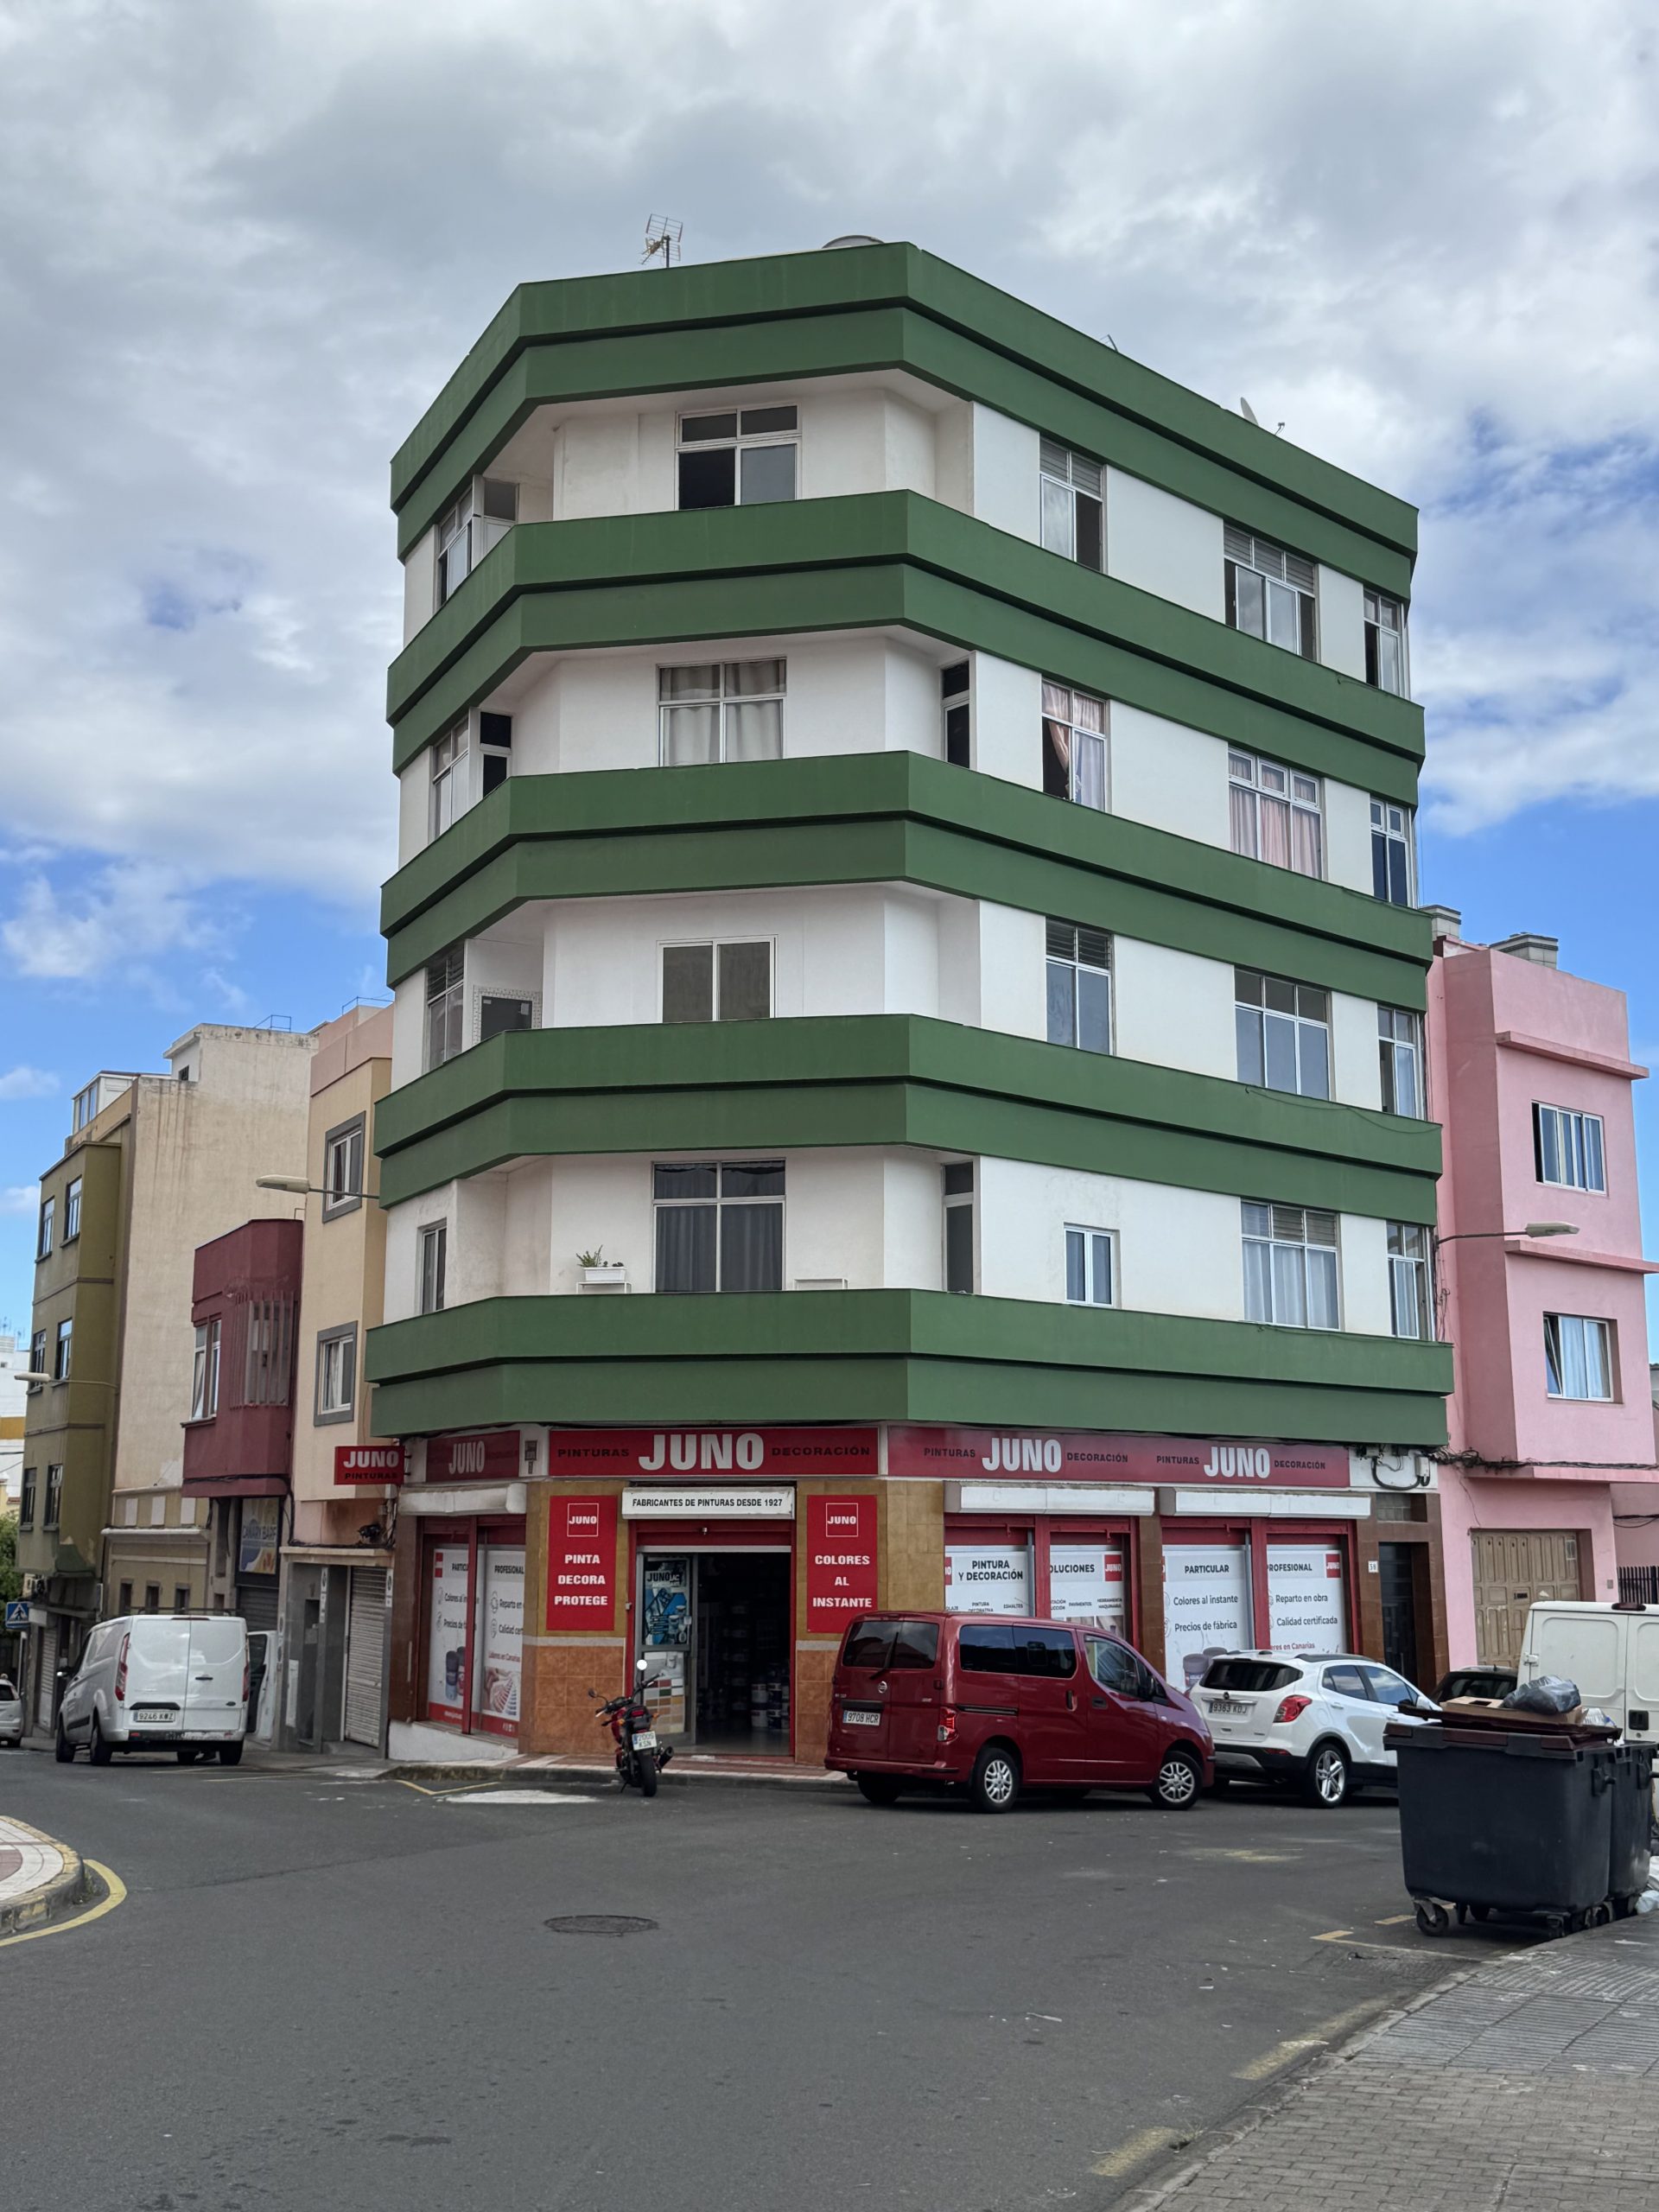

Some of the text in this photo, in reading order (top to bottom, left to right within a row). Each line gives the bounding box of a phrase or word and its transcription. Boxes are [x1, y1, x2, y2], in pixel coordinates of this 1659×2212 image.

[558, 1433, 870, 1470] PINTURAS JUNO DECORACIÓN
[924, 1437, 1128, 1473] PINTURAS JUNO DECORACIÓN
[343, 1451, 398, 1468] JUNO
[448, 1440, 485, 1475] JUNO
[1156, 1446, 1325, 1478] PINTURAS JUNO DECORACIÓN
[632, 1498, 783, 1507] FABRICANTES DE PINTURAS DESDE 1927
[569, 1516, 597, 1524] JUNO
[827, 1516, 857, 1524] JUNO
[564, 1554, 601, 1564] PINTA
[815, 1554, 870, 1565] COLORES
[972, 1560, 1010, 1569] PINTURA
[494, 1565, 524, 1574] PROFESIONAL
[1050, 1564, 1095, 1573] OLUCIONES
[1184, 1565, 1230, 1573] PARTICULAR
[557, 1574, 606, 1585] DECORA
[958, 1568, 1023, 1581] Y DECORACIÓN
[834, 1576, 849, 1586] AL
[554, 1595, 607, 1605] PROTEGE
[812, 1597, 872, 1607] INSTANTE
[1173, 1594, 1238, 1605] Colores al instante
[1275, 1594, 1302, 1605] Reparto
[1313, 1593, 1328, 1602] obra
[1174, 1620, 1237, 1632] Precios de fábrica
[1276, 1615, 1338, 1626] Calidad certificada
[1291, 1641, 1315, 1649] Canarias
[865, 1713, 880, 1724] HCR
